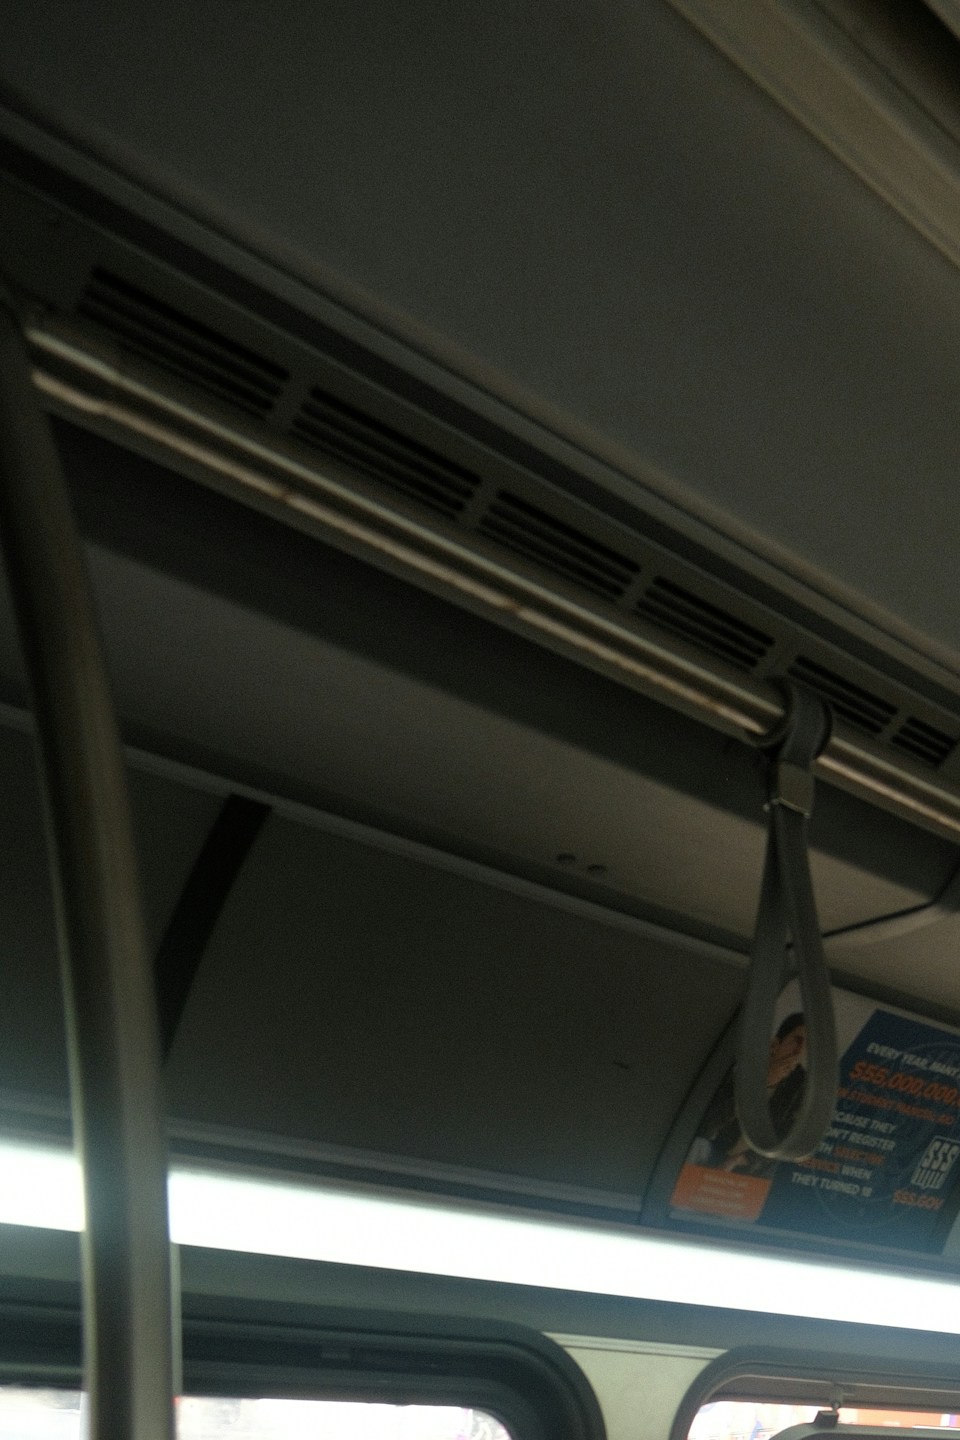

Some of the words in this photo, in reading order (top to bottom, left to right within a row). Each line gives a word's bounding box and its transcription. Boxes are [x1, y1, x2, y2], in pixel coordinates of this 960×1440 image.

[866, 1042, 899, 1060] EVERY
[833, 1111, 870, 1128] CAUSE
[921, 1140, 960, 1172] SSS
[791, 1171, 820, 1187] THEY
[819, 1177, 860, 1196] TURNED
